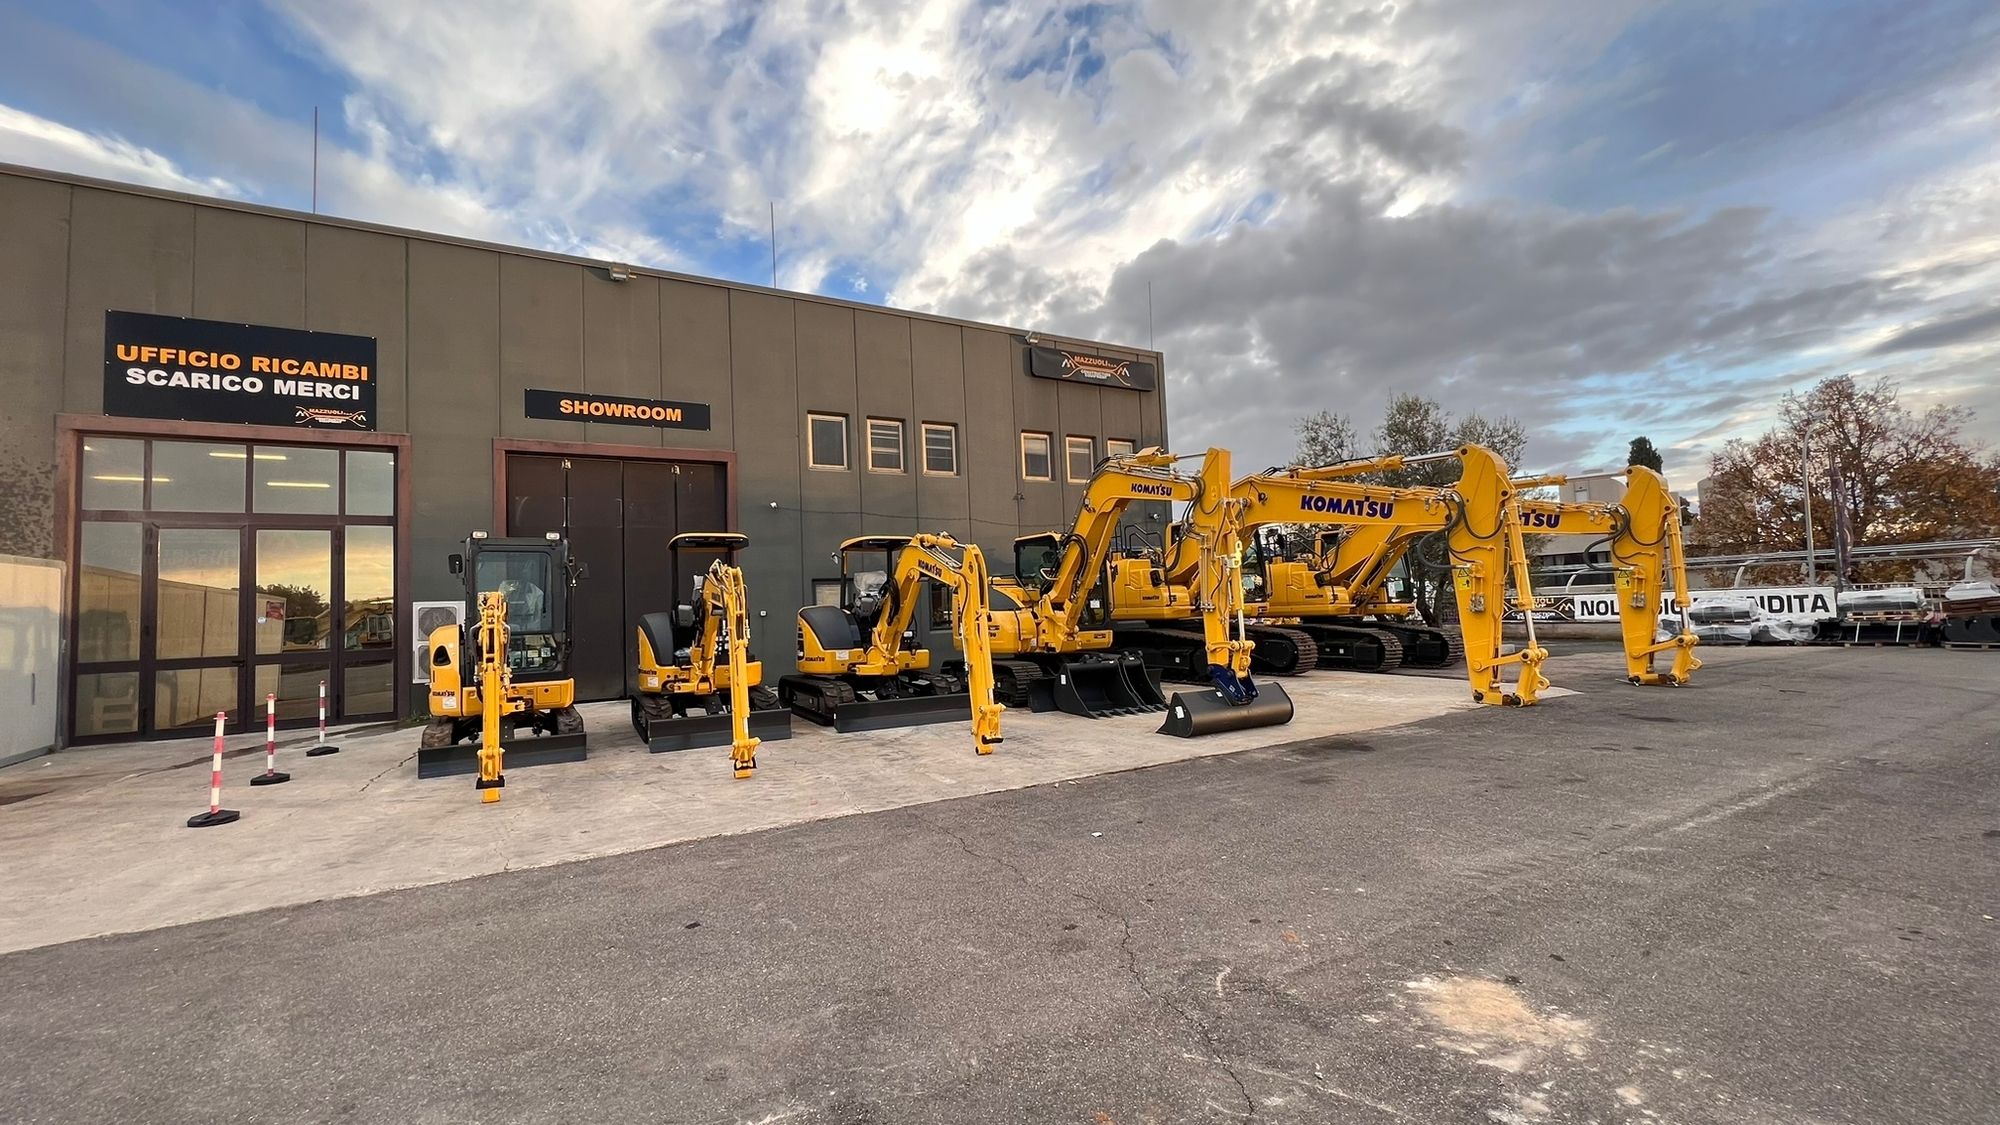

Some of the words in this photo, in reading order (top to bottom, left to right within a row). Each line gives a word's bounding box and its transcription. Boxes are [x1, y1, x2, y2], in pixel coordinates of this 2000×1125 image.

[116, 344, 241, 370] UFFICIO
[252, 356, 369, 381] RICAMBI
[1074, 355, 1108, 367] MAZZUOLI
[126, 367, 263, 393] SCARICO
[273, 379, 359, 401] MERCI
[559, 399, 682, 422] SHOWROOM
[1131, 483, 1173, 496] KOMATSU
[1300, 495, 1394, 519] KOMATSU
